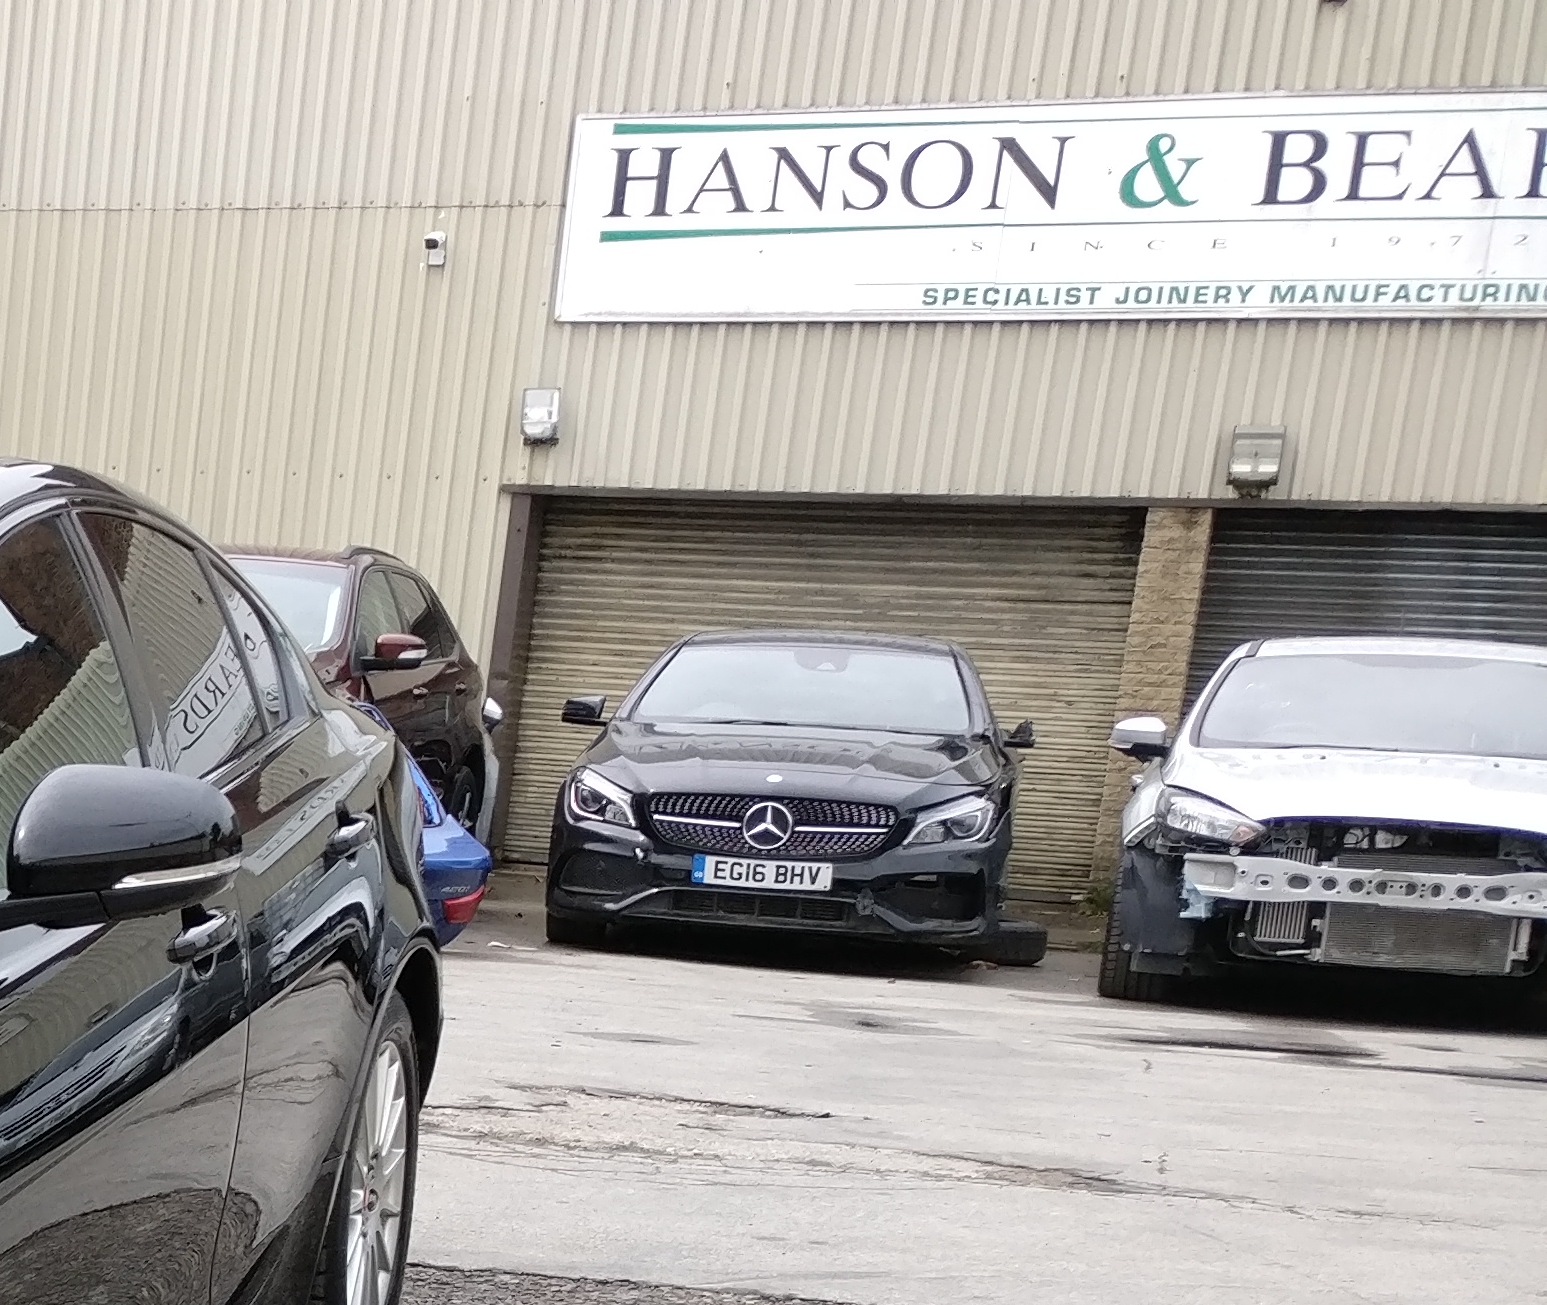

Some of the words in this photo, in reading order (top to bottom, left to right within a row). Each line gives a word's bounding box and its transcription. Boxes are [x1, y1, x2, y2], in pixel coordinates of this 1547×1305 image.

[602, 136, 1075, 218] HANSON
[1119, 132, 1203, 209] &
[922, 285, 1102, 306] SPECIALIST
[1115, 284, 1255, 305] JOINERY
[1269, 282, 1547, 304] MANUFACTURIN
[713, 860, 766, 883] EG16
[773, 865, 822, 886] BHV
